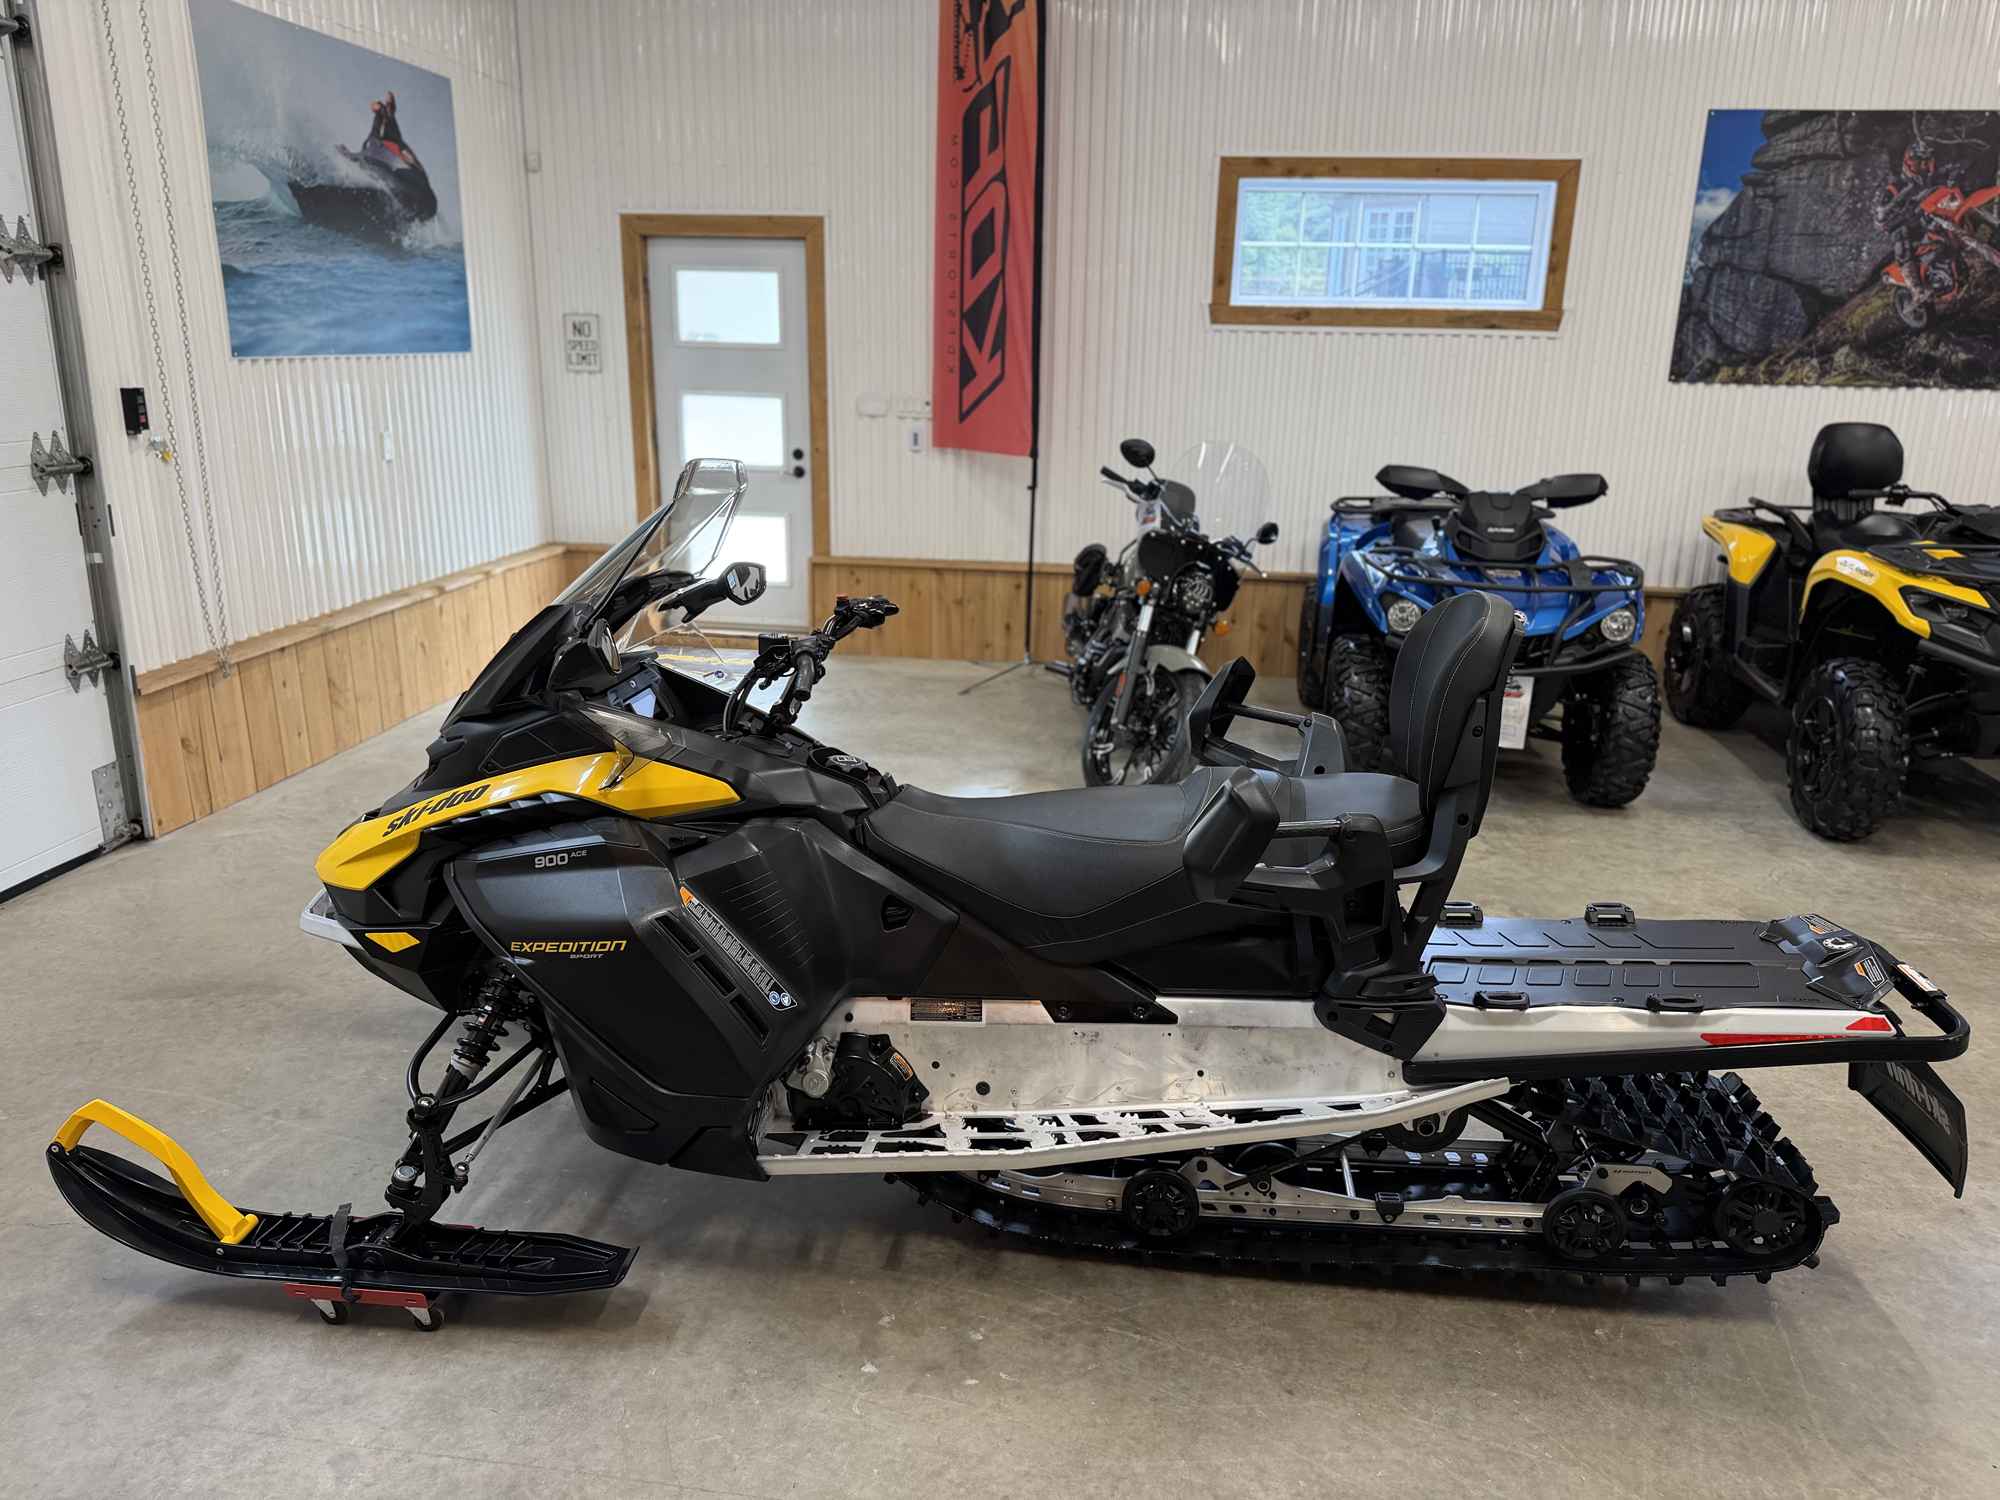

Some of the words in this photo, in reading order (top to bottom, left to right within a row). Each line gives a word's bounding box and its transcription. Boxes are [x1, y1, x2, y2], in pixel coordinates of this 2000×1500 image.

[572, 320, 591, 338] NO
[567, 339, 598, 351] SPEED
[568, 352, 598, 366] LIMIT
[534, 853, 569, 869] 900
[570, 849, 588, 858] ACE
[510, 940, 628, 953] EXPEDITION
